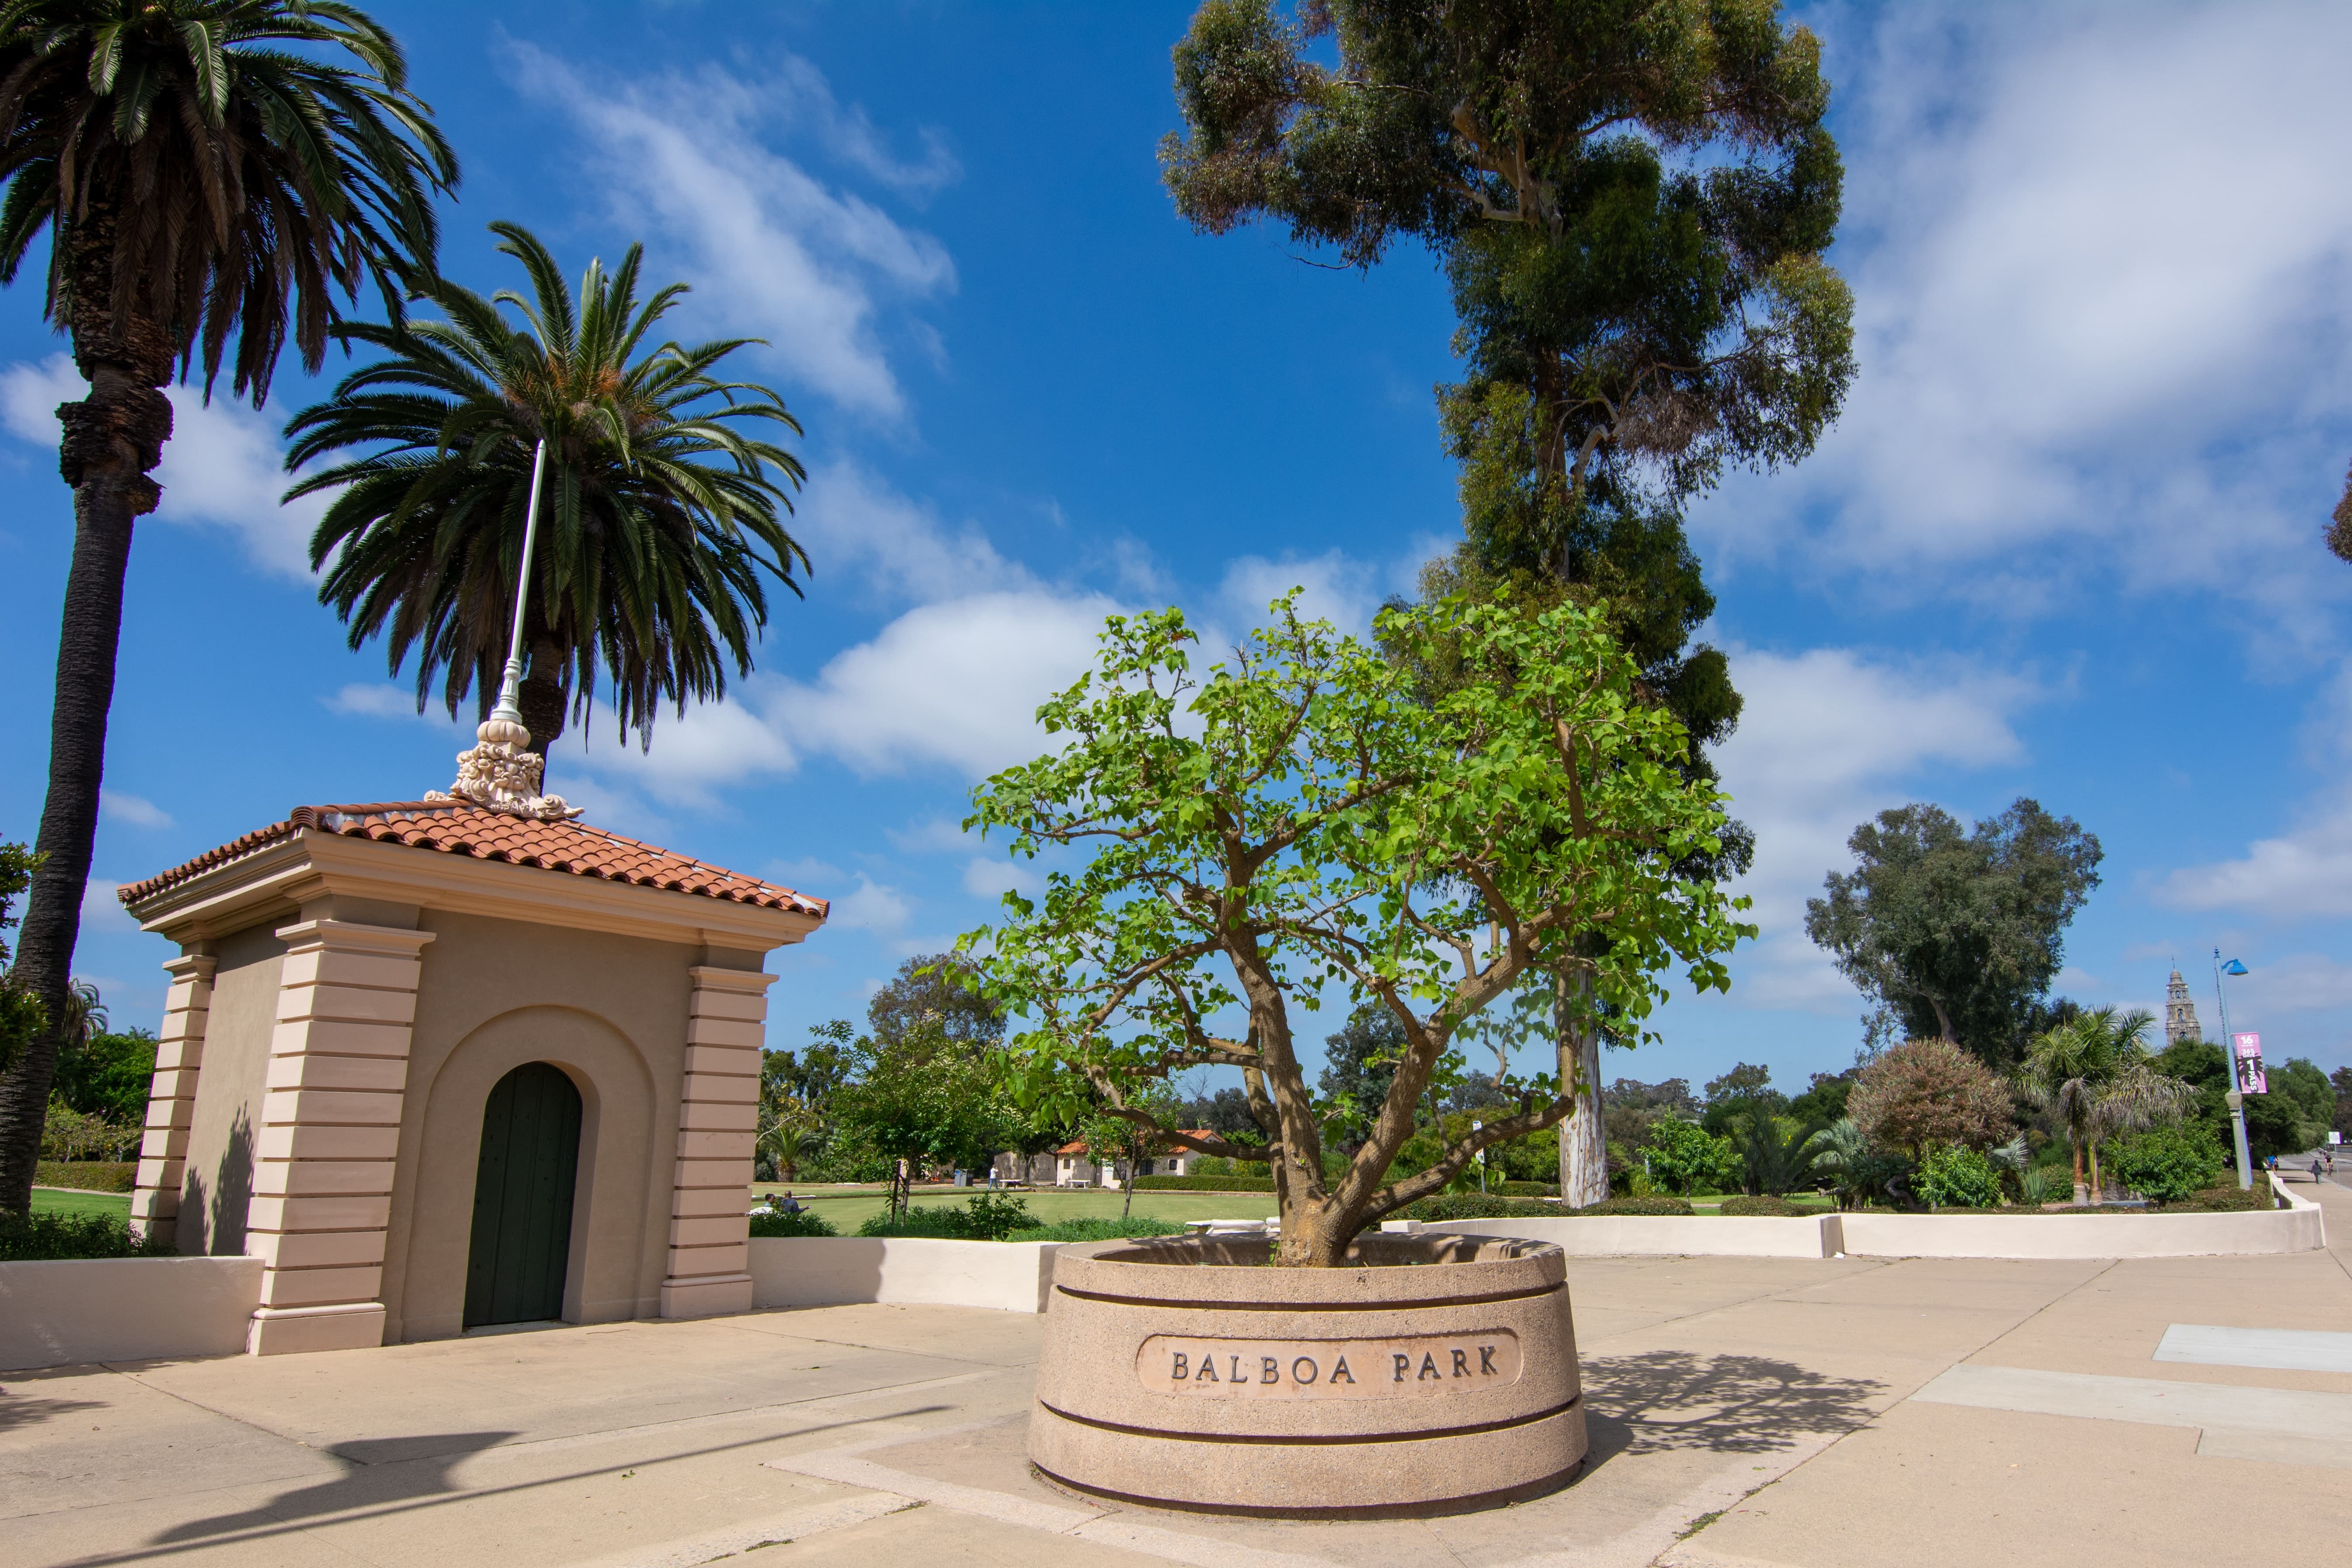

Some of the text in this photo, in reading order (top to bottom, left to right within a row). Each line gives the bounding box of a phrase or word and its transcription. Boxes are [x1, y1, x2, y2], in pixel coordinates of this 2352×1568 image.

[2240, 1035, 2253, 1044] 16
[2247, 1059, 2257, 1090] 1 PASS
[1171, 1345, 1498, 1385] BALBOA PARK
